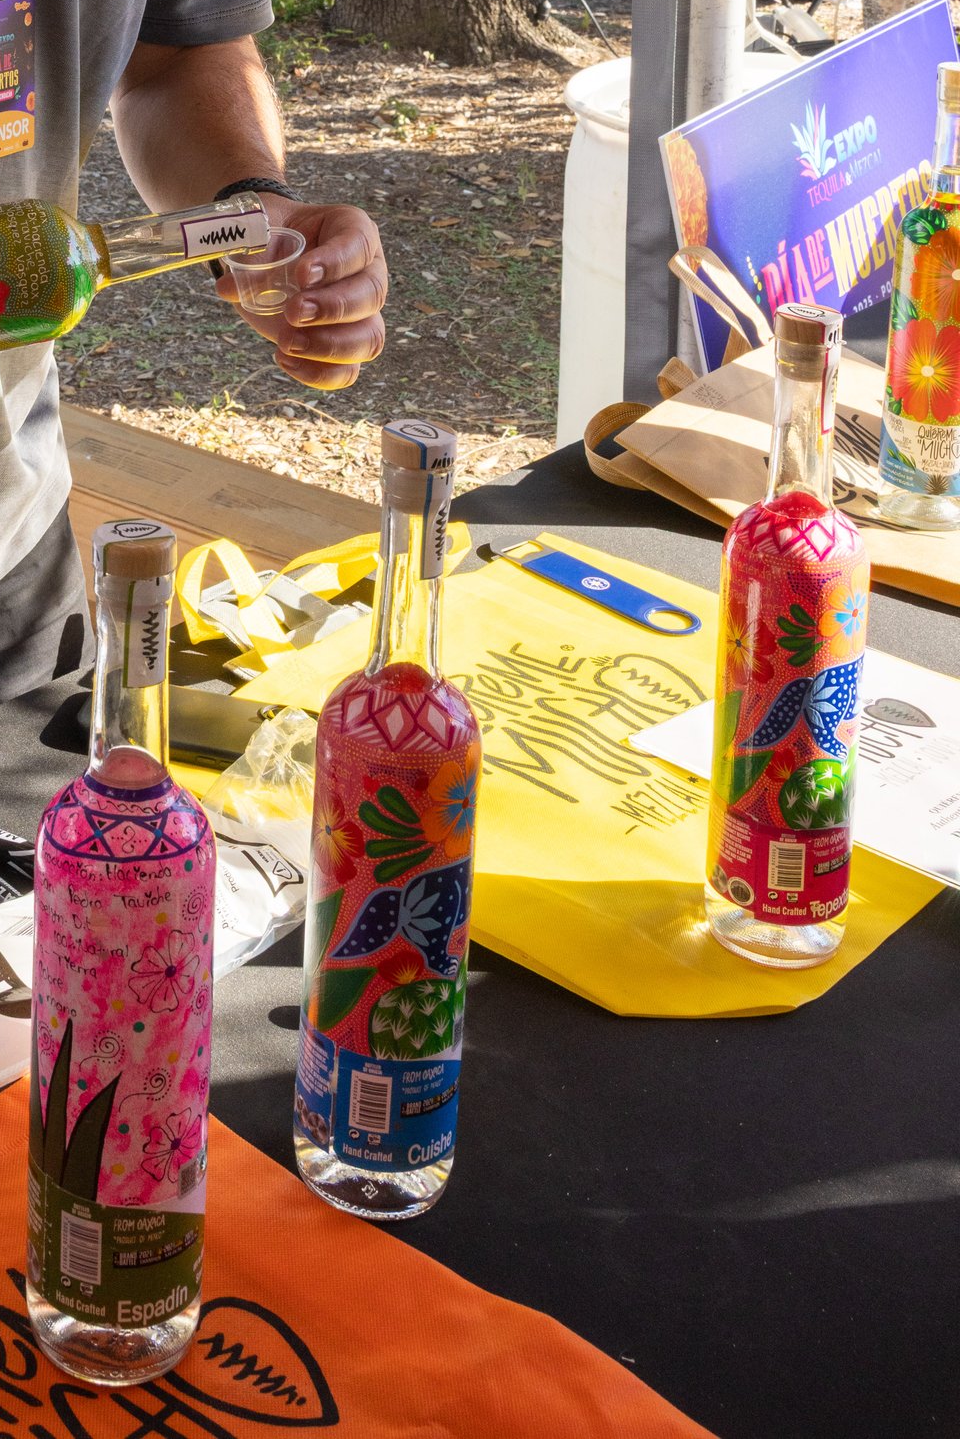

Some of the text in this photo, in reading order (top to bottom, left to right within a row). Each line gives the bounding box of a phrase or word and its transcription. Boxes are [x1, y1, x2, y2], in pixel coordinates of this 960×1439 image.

[834, 114, 877, 163] EXPO
[762, 903, 807, 916] Hand Crafted
[402, 1071, 422, 1084] FROM
[342, 1142, 393, 1162] Hand Crafted
[407, 1130, 452, 1165] Cuishe
[113, 1215, 166, 1232] FROM OAXACA
[55, 1289, 106, 1317] Hand Crafted
[117, 1285, 188, 1325] Espadín
